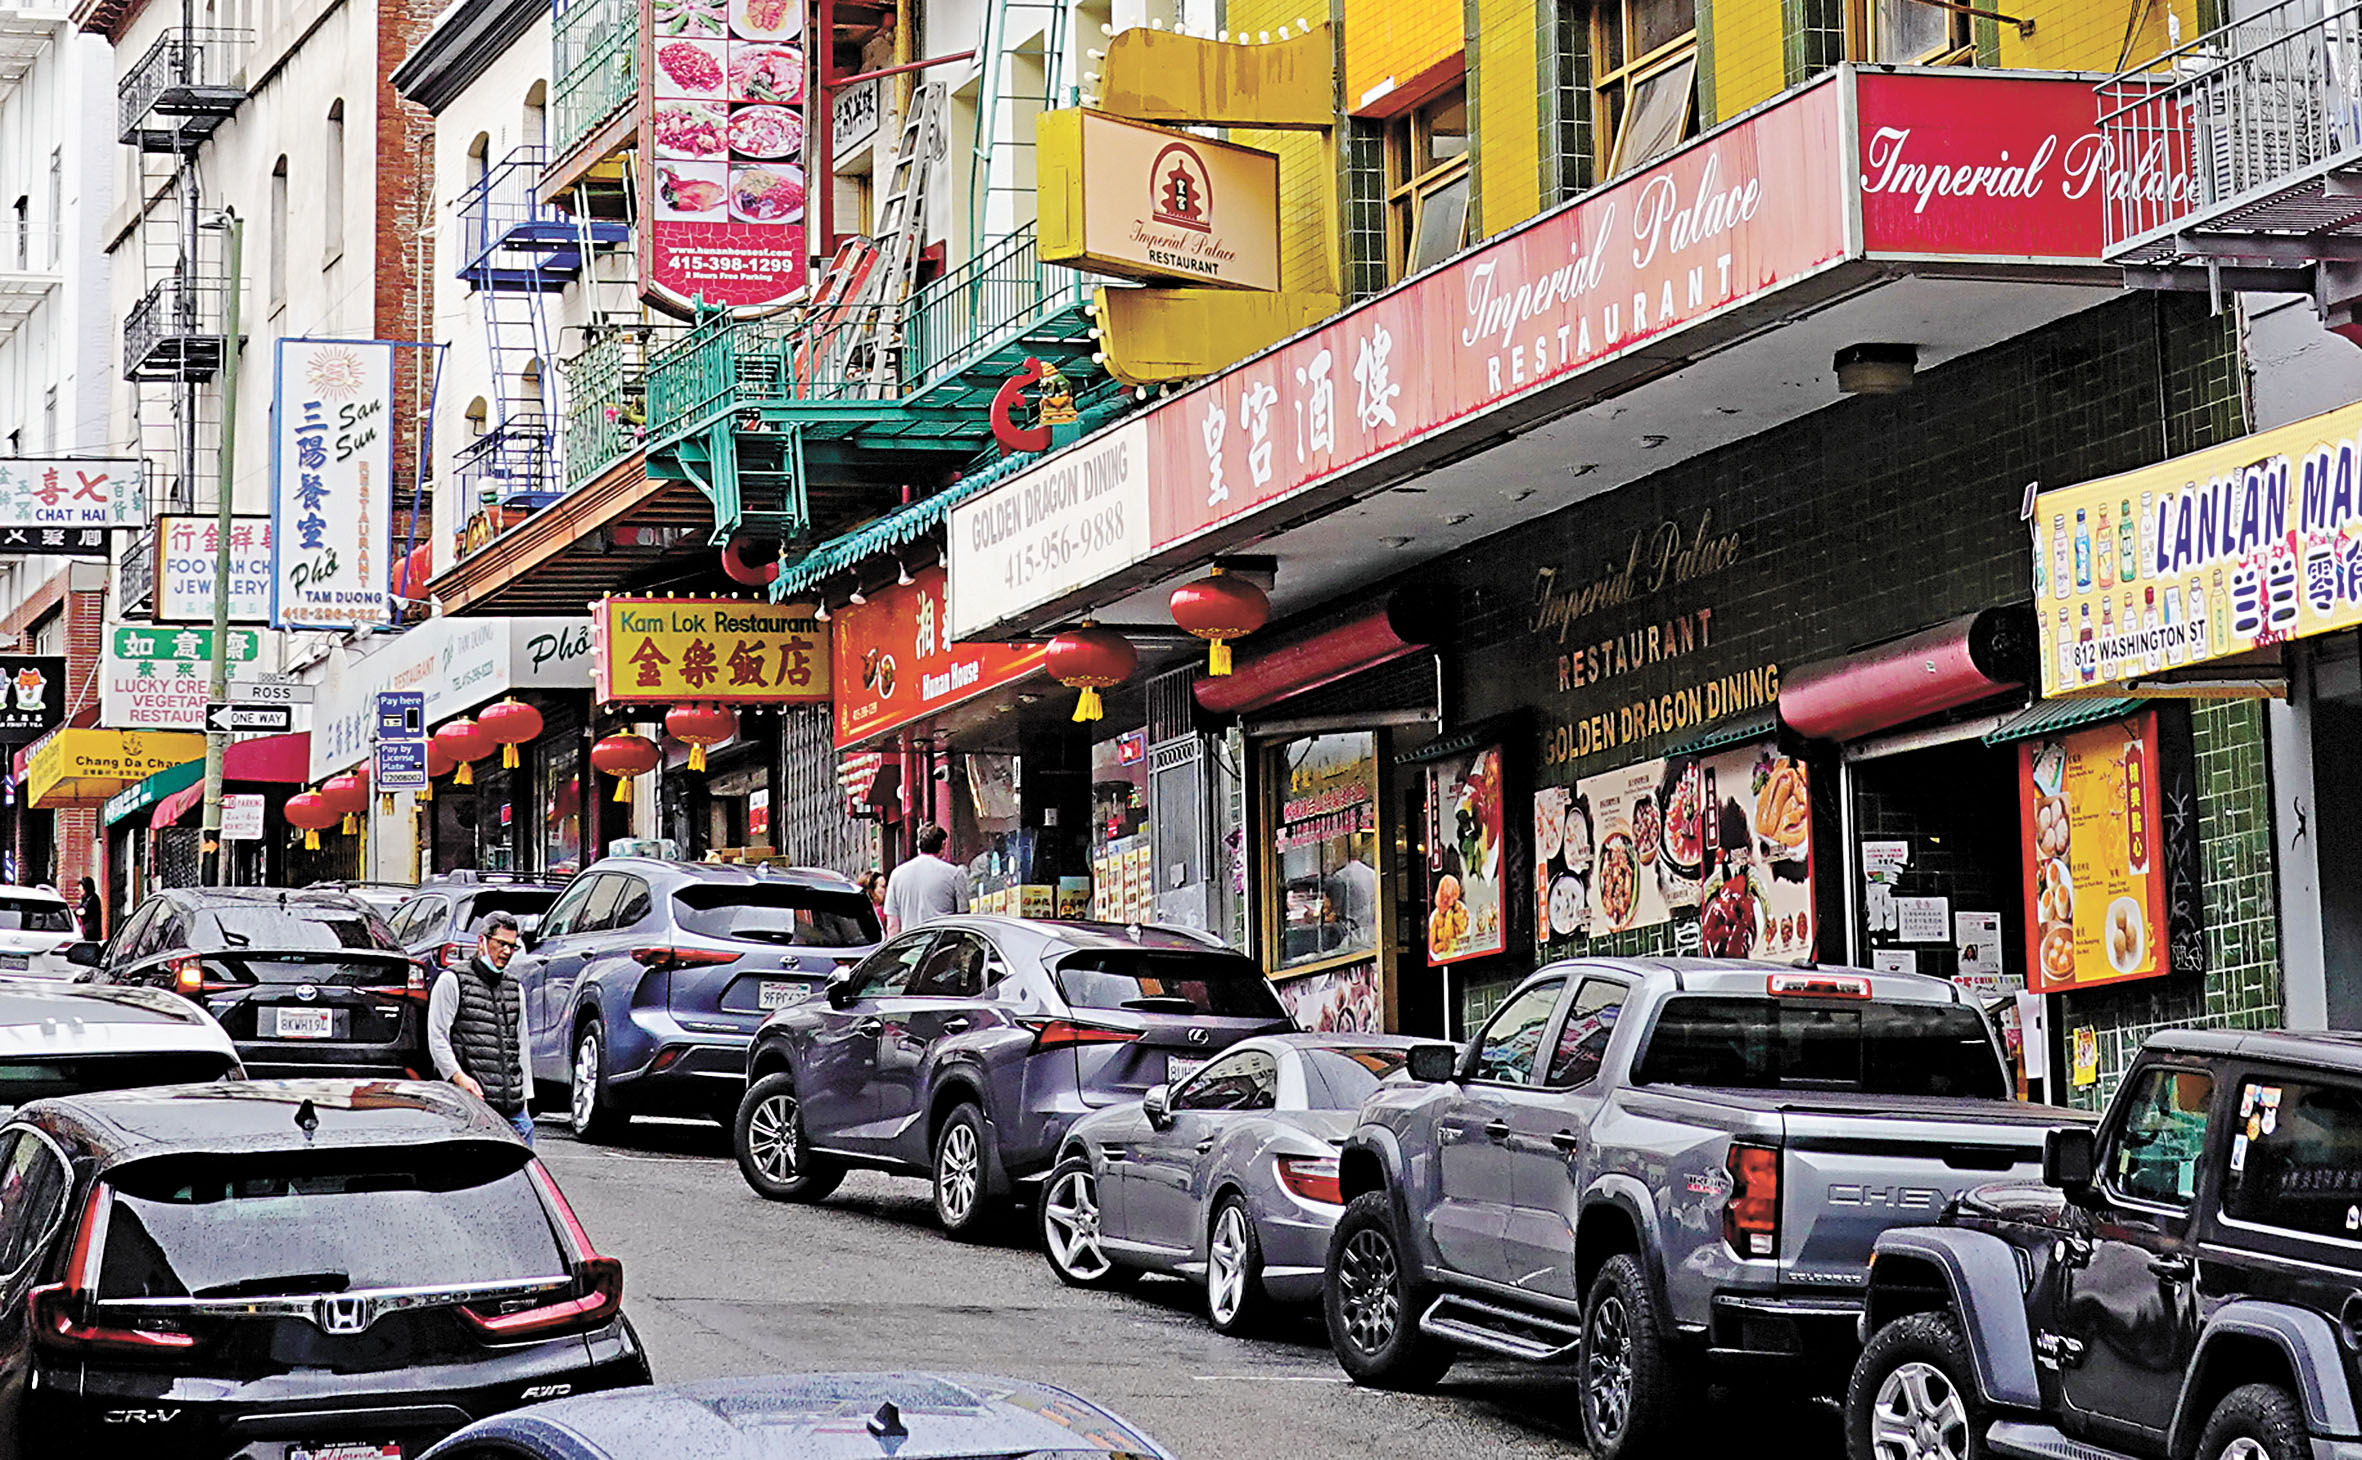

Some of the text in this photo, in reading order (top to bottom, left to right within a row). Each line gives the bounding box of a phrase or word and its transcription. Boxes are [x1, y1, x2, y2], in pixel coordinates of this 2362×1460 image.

[1860, 126, 2057, 214] Imperial
[1129, 219, 1236, 262] Imperial Palace
[1462, 153, 1761, 348] Imperial Palace
[668, 256, 793, 273] 415-398-1299
[1149, 250, 1219, 275] RESTAURANT
[740, 273, 773, 282] Parking
[1488, 253, 1733, 395] RESTAURANT
[339, 399, 381, 431] San
[336, 427, 377, 462] Sun
[294, 401, 331, 550] 三陽餐室
[971, 439, 1129, 553] GOLDEN DRAGON DINING
[2156, 437, 2362, 573] LANLAN MA
[36, 509, 106, 521] CHAT HAI
[358, 461, 370, 588] RESTAURANT
[1005, 502, 1125, 589] 415-956-9888
[167, 559, 206, 573] FOO
[1529, 507, 1741, 645] Imperial Palace
[305, 590, 382, 604] TAM DUONG
[621, 611, 822, 634] Kam Lok Restaurant
[1559, 607, 1712, 692] RESTAURANT
[2074, 619, 2205, 668] 812 WASHINGTON ST
[628, 636, 815, 689] 金樂飯店
[115, 679, 170, 693] LUCKY
[253, 687, 291, 699] ROSS
[922, 660, 979, 701] Hunan House
[381, 696, 422, 707] Pay here
[1544, 664, 1779, 766] GOLDEN DRAGON DINING
[231, 713, 283, 724] ONE WAY
[76, 756, 119, 769] Chang
[125, 757, 142, 768] Da
[382, 745, 412, 754] Pay by
[382, 754, 414, 762] License
[382, 762, 405, 770] Plate
[521, 1384, 572, 1400] AWD
[103, 1408, 181, 1423] CR-V
